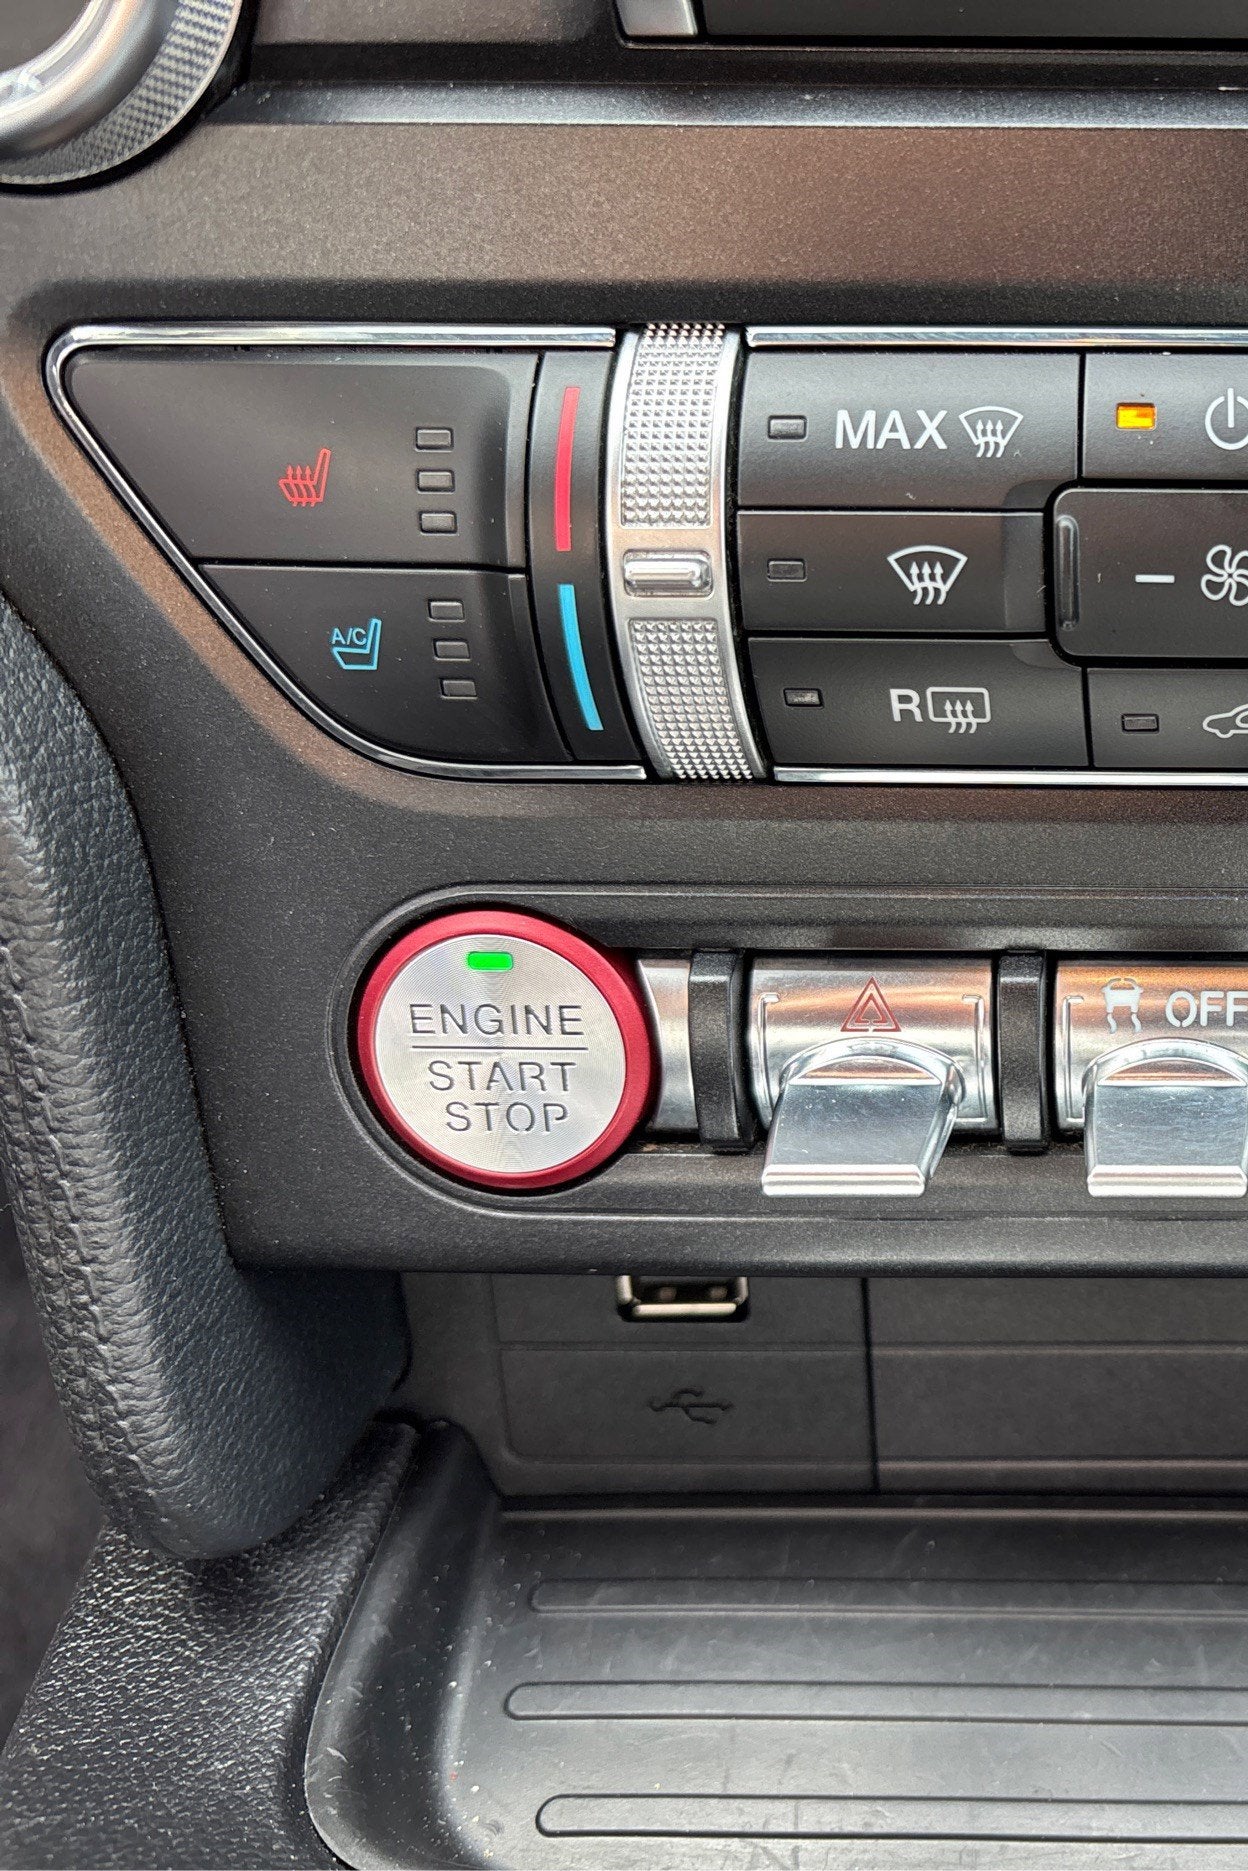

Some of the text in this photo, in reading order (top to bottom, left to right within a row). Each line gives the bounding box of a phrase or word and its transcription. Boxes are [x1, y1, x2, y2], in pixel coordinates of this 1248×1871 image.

[834, 411, 947, 450] MAX
[331, 627, 367, 646] A/C
[889, 688, 921, 724] R
[408, 1003, 585, 1036] ENGINE
[428, 1060, 577, 1092] START
[445, 1101, 569, 1133] STOP
